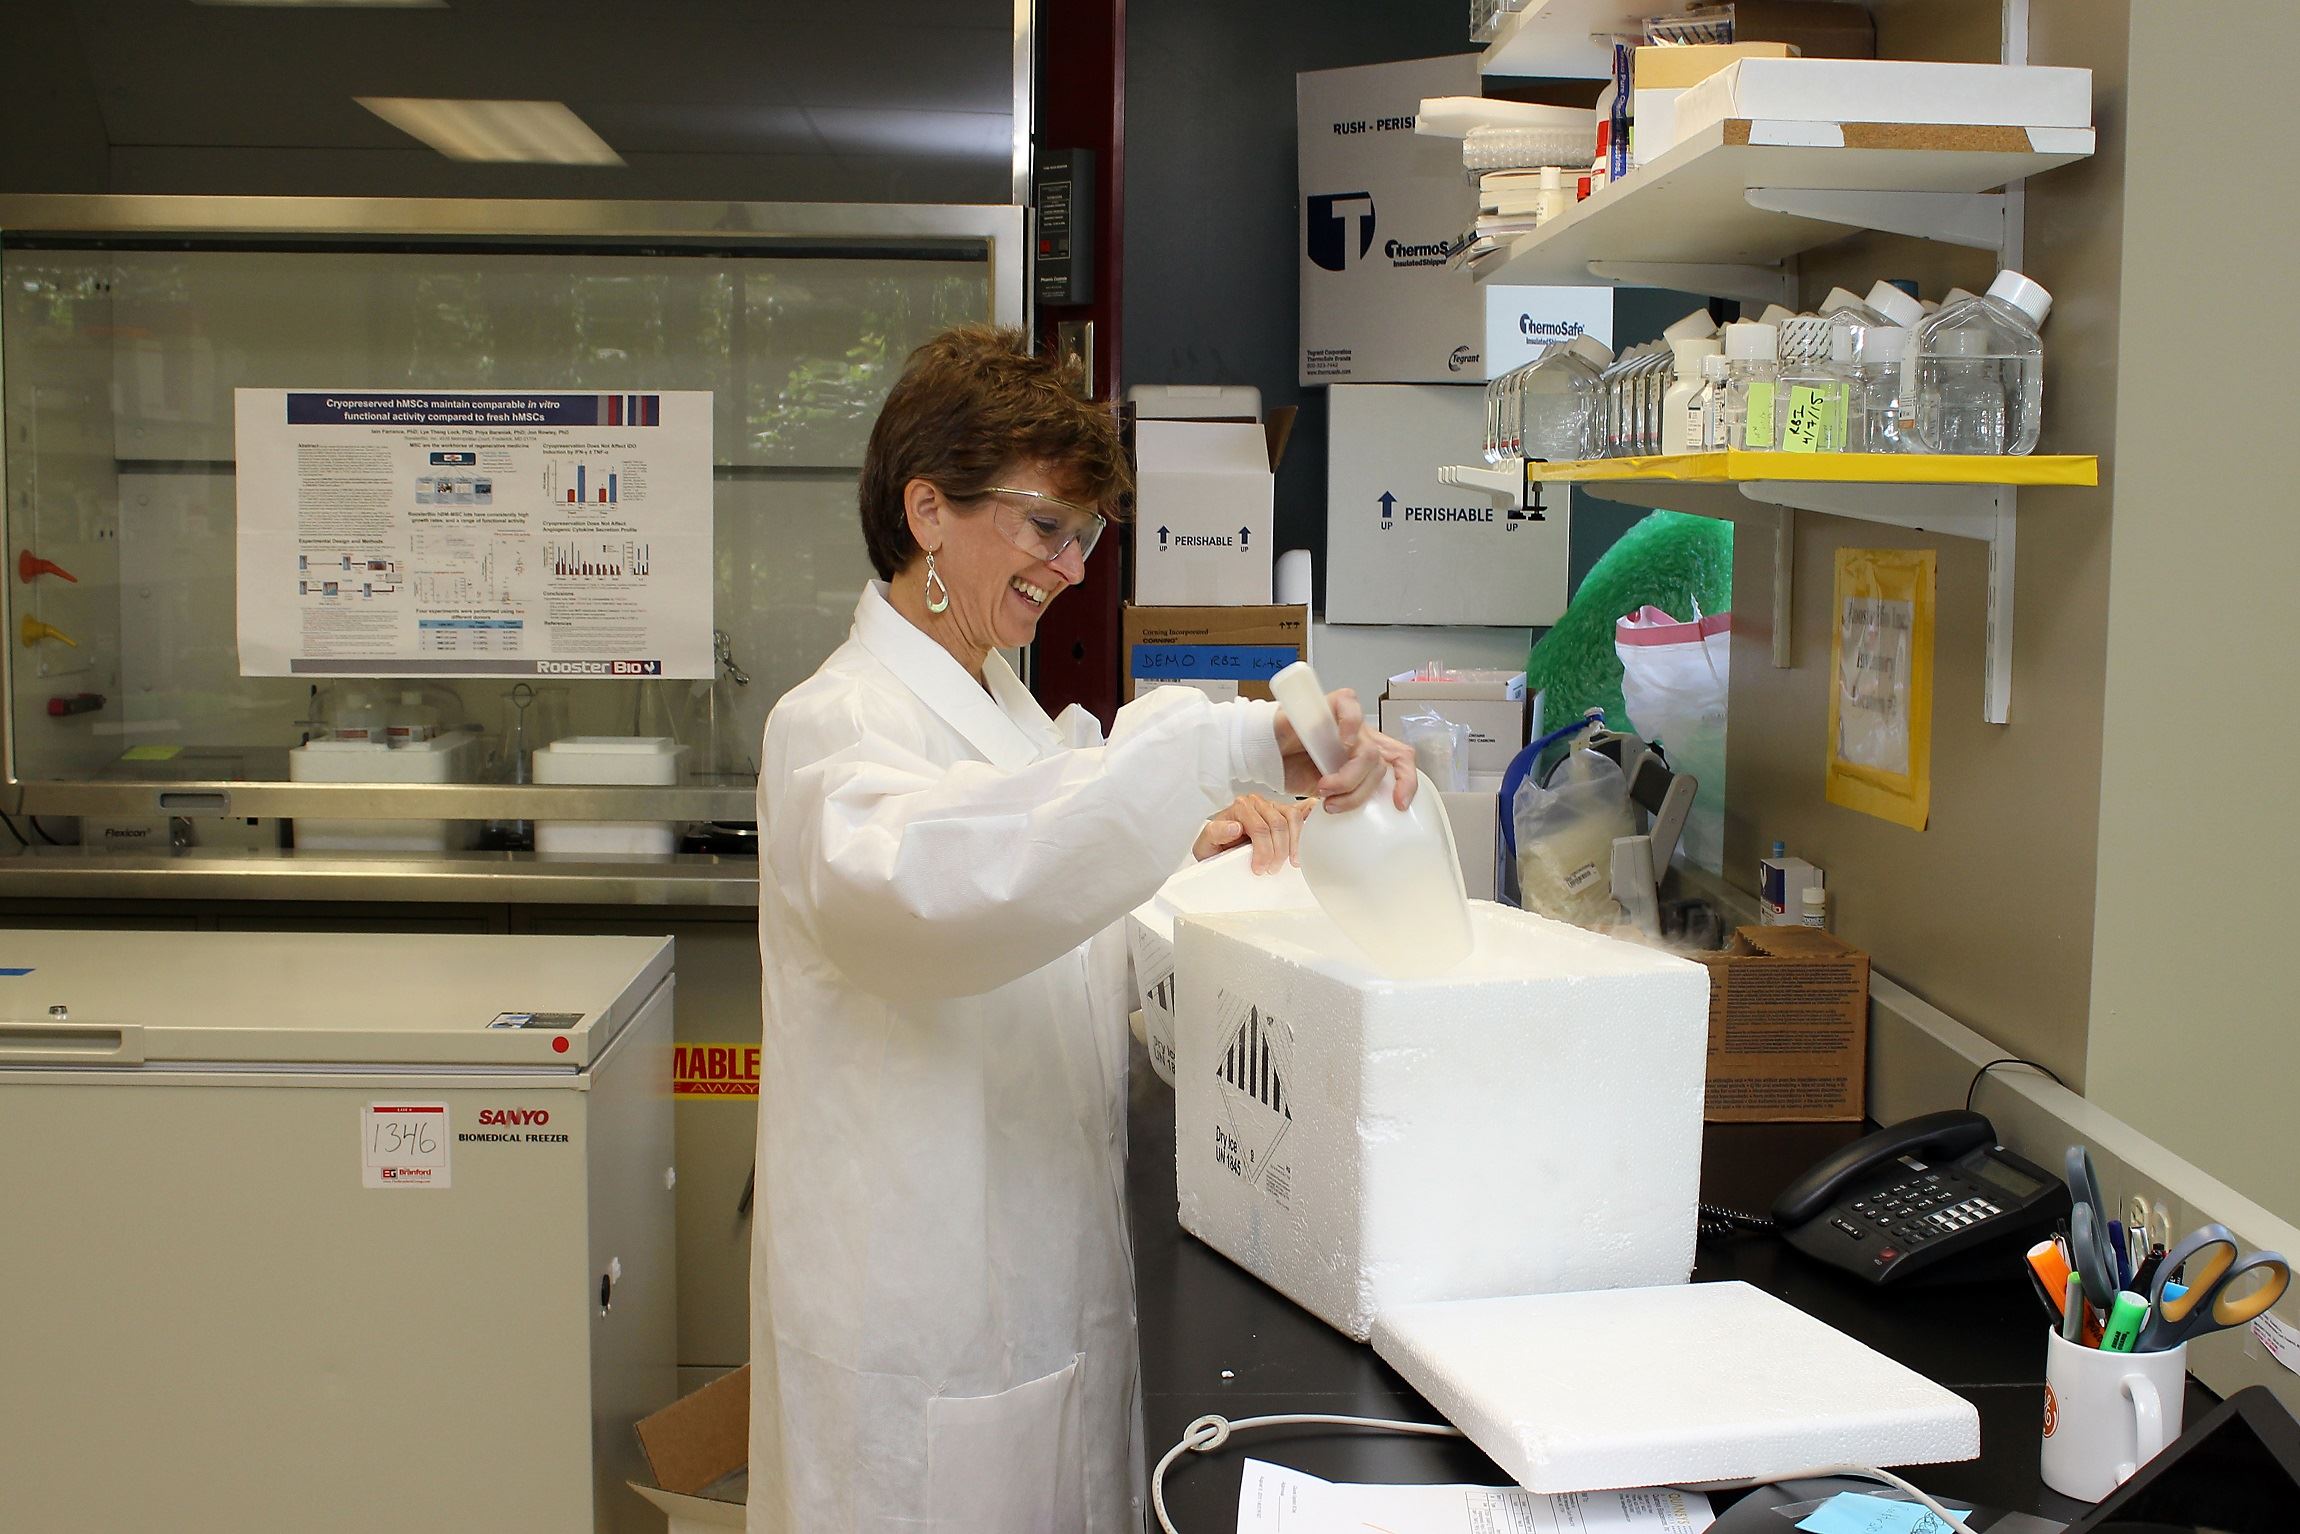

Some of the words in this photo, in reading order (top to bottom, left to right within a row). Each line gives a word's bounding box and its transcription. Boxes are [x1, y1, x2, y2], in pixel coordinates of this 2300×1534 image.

[1333, 121, 1366, 135] RUSH
[1453, 354, 1479, 365] Tegrant
[327, 399, 394, 410] Cryopreserved
[396, 399, 428, 408] hMSCs
[431, 399, 470, 409] maintain
[472, 399, 525, 411] comparable
[528, 400, 536, 409] in
[539, 400, 560, 409] vitro
[344, 411, 391, 421] functional
[392, 412, 426, 423] activity
[428, 412, 474, 423] compared
[475, 413, 484, 422] to
[486, 412, 510, 422] fresh
[512, 412, 544, 422] hMSCs
[1789, 405, 1804, 434] RBI
[1802, 391, 1824, 444] 4/7/15
[1405, 507, 1493, 522] PERISHABLE
[1381, 521, 1392, 530] UP
[1506, 523, 1518, 532] UP
[1175, 536, 1232, 546] PERISHABLE
[1142, 654, 1195, 668] DEMO
[1211, 656, 1241, 667] RBI
[105, 828, 146, 837] Flexicon
[690, 1083, 758, 1093] AWAY
[479, 1109, 549, 1126] SANYO
[374, 1122, 437, 1155] 1346
[459, 1134, 521, 1142] BIOMEDICAL
[526, 1134, 569, 1142] FREEZER
[1216, 1125, 1227, 1150] Dry
[1228, 1134, 1237, 1153] Ice
[1216, 1145, 1225, 1164] UN
[1227, 1153, 1241, 1176] 1845
[399, 1168, 432, 1176] Branford
